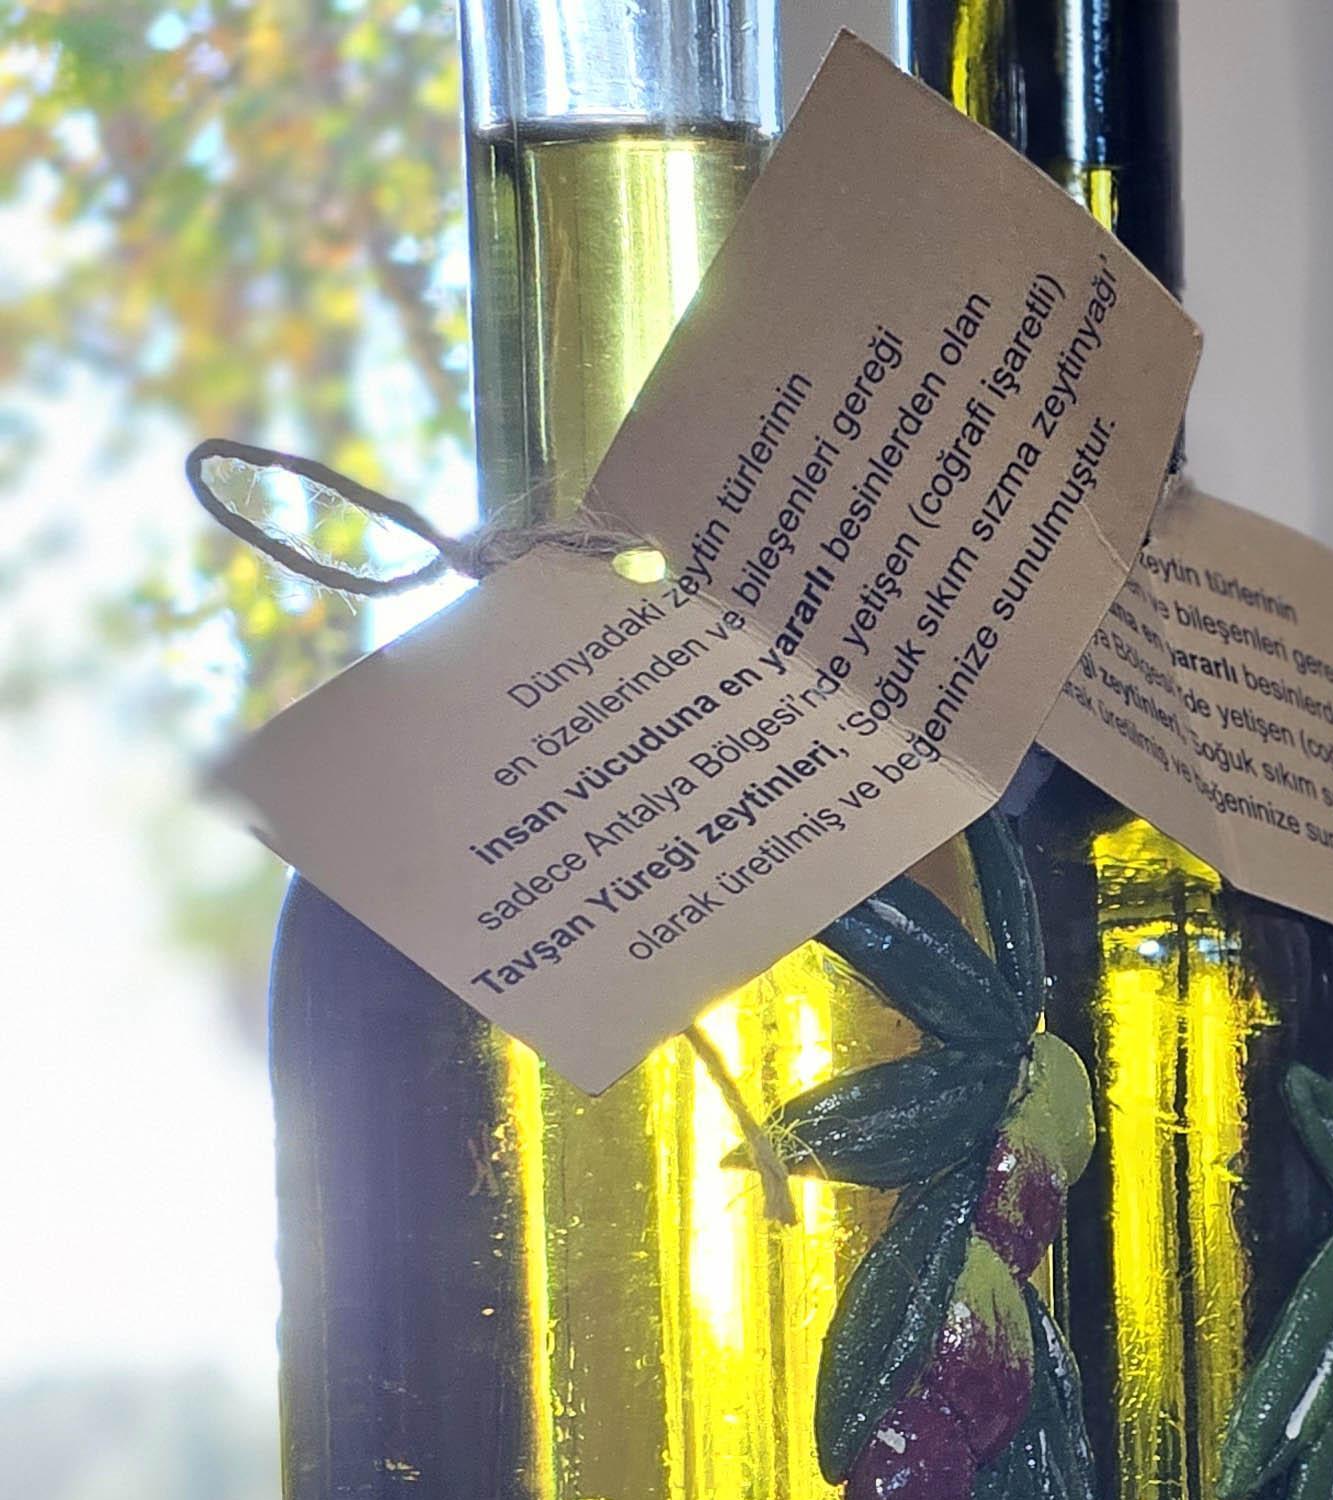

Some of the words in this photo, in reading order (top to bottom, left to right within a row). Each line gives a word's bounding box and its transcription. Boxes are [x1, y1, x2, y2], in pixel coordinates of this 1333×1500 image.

[469, 800, 568, 865] insan
[564, 693, 720, 800] vücuduna
[719, 667, 762, 697] en
[758, 564, 835, 675] yararlı
[820, 371, 946, 563] besinlerden
[940, 294, 991, 366] olan
[470, 913, 595, 995] Tavşan
[584, 835, 700, 915] Yüreği
[696, 739, 850, 845] zeytinleri,
[917, 546, 979, 637] sıkım
[971, 441, 1041, 542] sızma
[477, 852, 587, 930] sadece
[583, 775, 698, 857] Antalya
[843, 532, 920, 655] yetişen
[908, 398, 996, 528] (coğrafi
[980, 273, 1066, 400] işaretli)
[494, 755, 537, 787] en
[531, 635, 707, 756] özellerinden
[707, 609, 745, 641] ve
[732, 435, 840, 608] bileşenleri
[833, 325, 903, 440] gereği
[507, 597, 666, 708] Dünyadaki
[662, 517, 730, 608] zeytin
[717, 371, 813, 515] türlerinin
[628, 889, 724, 960] olarak
[715, 806, 846, 897] üretilmiş
[838, 780, 880, 809] ve
[873, 624, 998, 785] beğeninize
[992, 416, 1116, 621] sunulmuştur.
